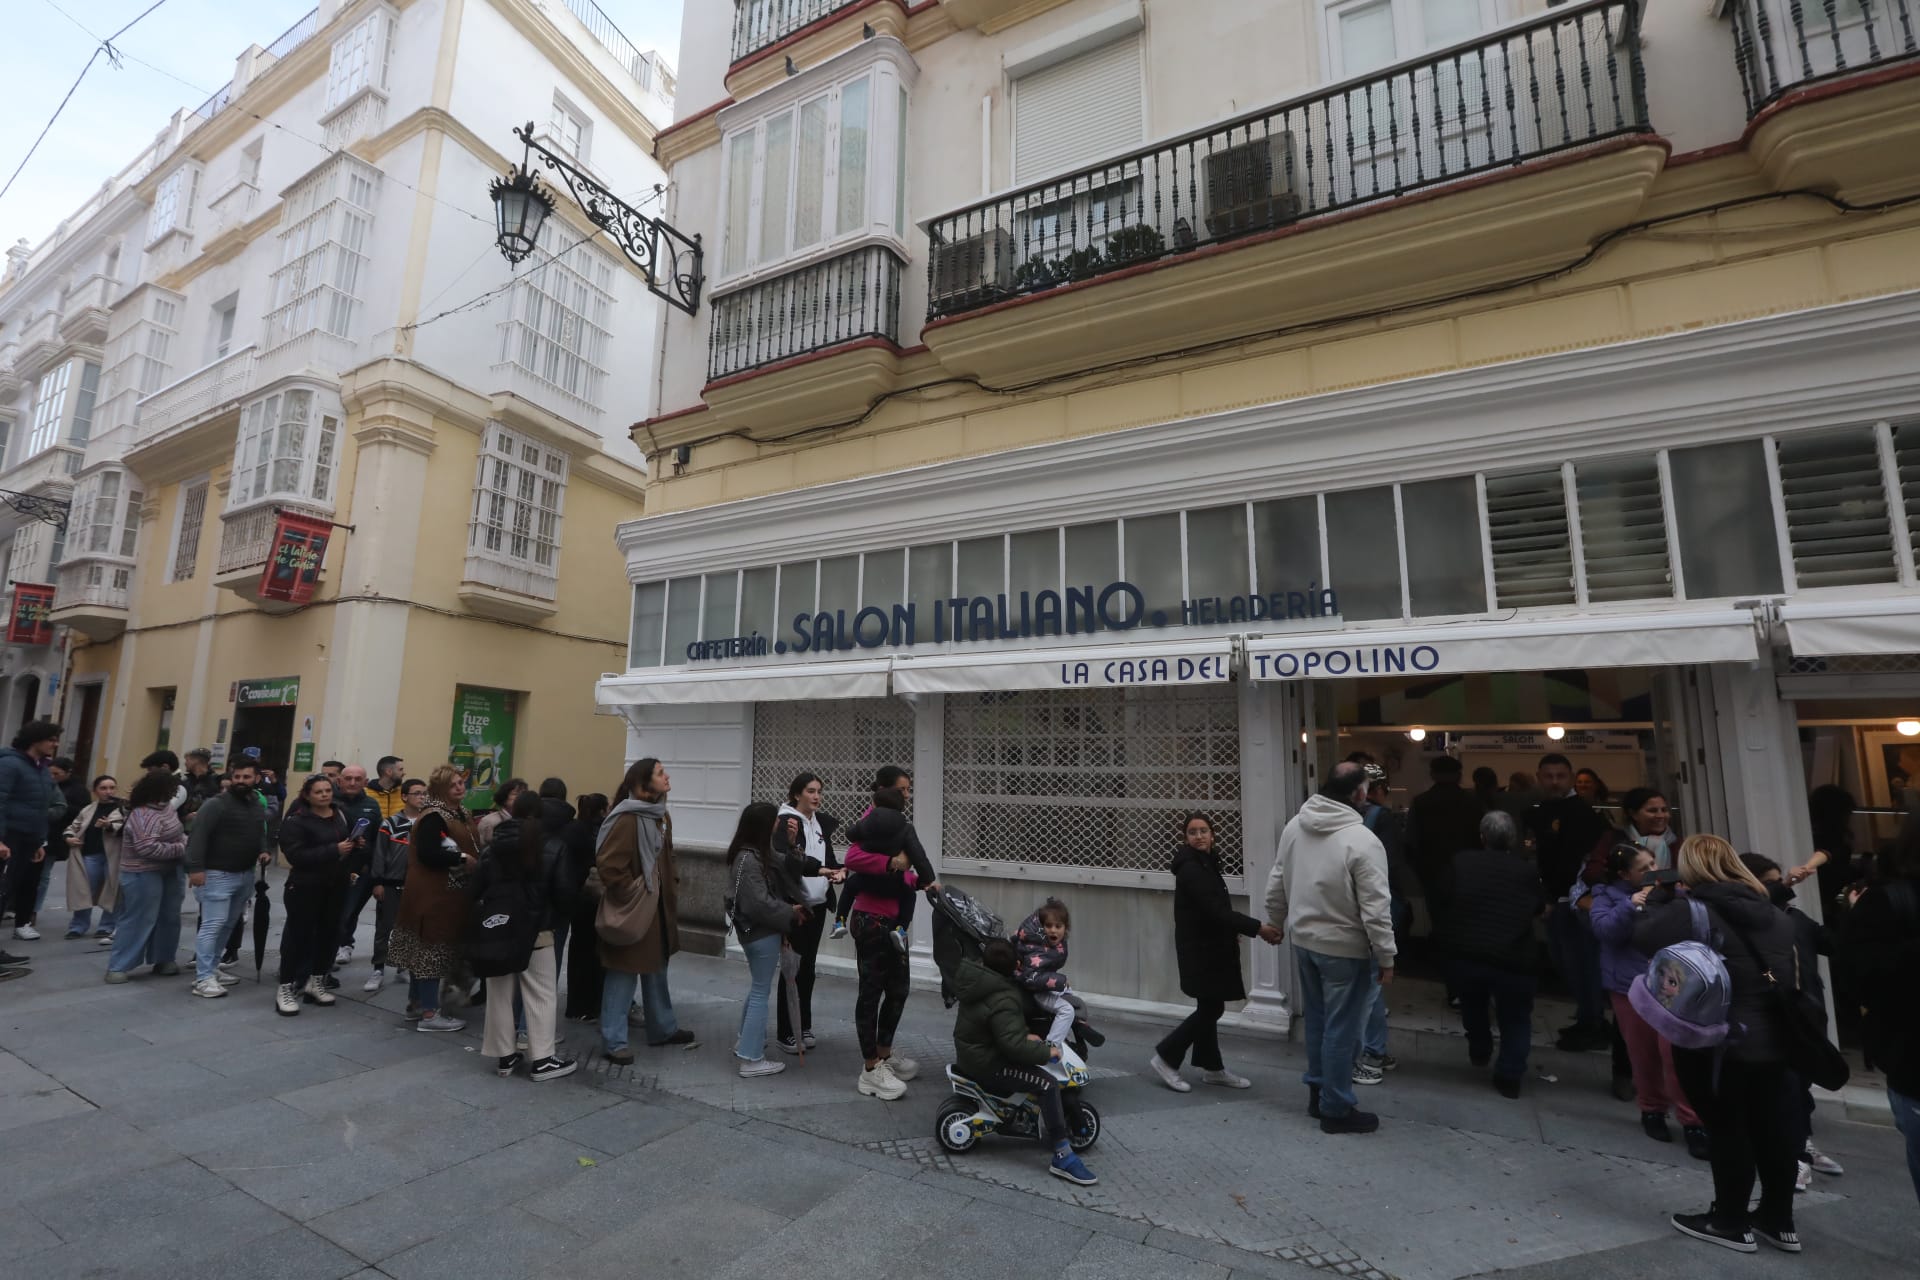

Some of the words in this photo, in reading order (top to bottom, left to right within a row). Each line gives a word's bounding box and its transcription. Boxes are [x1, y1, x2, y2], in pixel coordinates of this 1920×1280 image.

[686, 631, 767, 661] CAFETERÍA
[791, 602, 916, 652] SALON
[933, 581, 1145, 644] ITALIANO
[1181, 582, 1339, 626] HELADERÍA
[1061, 662, 1089, 684] LA
[1104, 659, 1167, 683] CASA
[1177, 656, 1226, 681] DEL
[1254, 645, 1440, 679] TOPOLINO
[462, 724, 482, 735] tea
[463, 711, 490, 726] fuze
